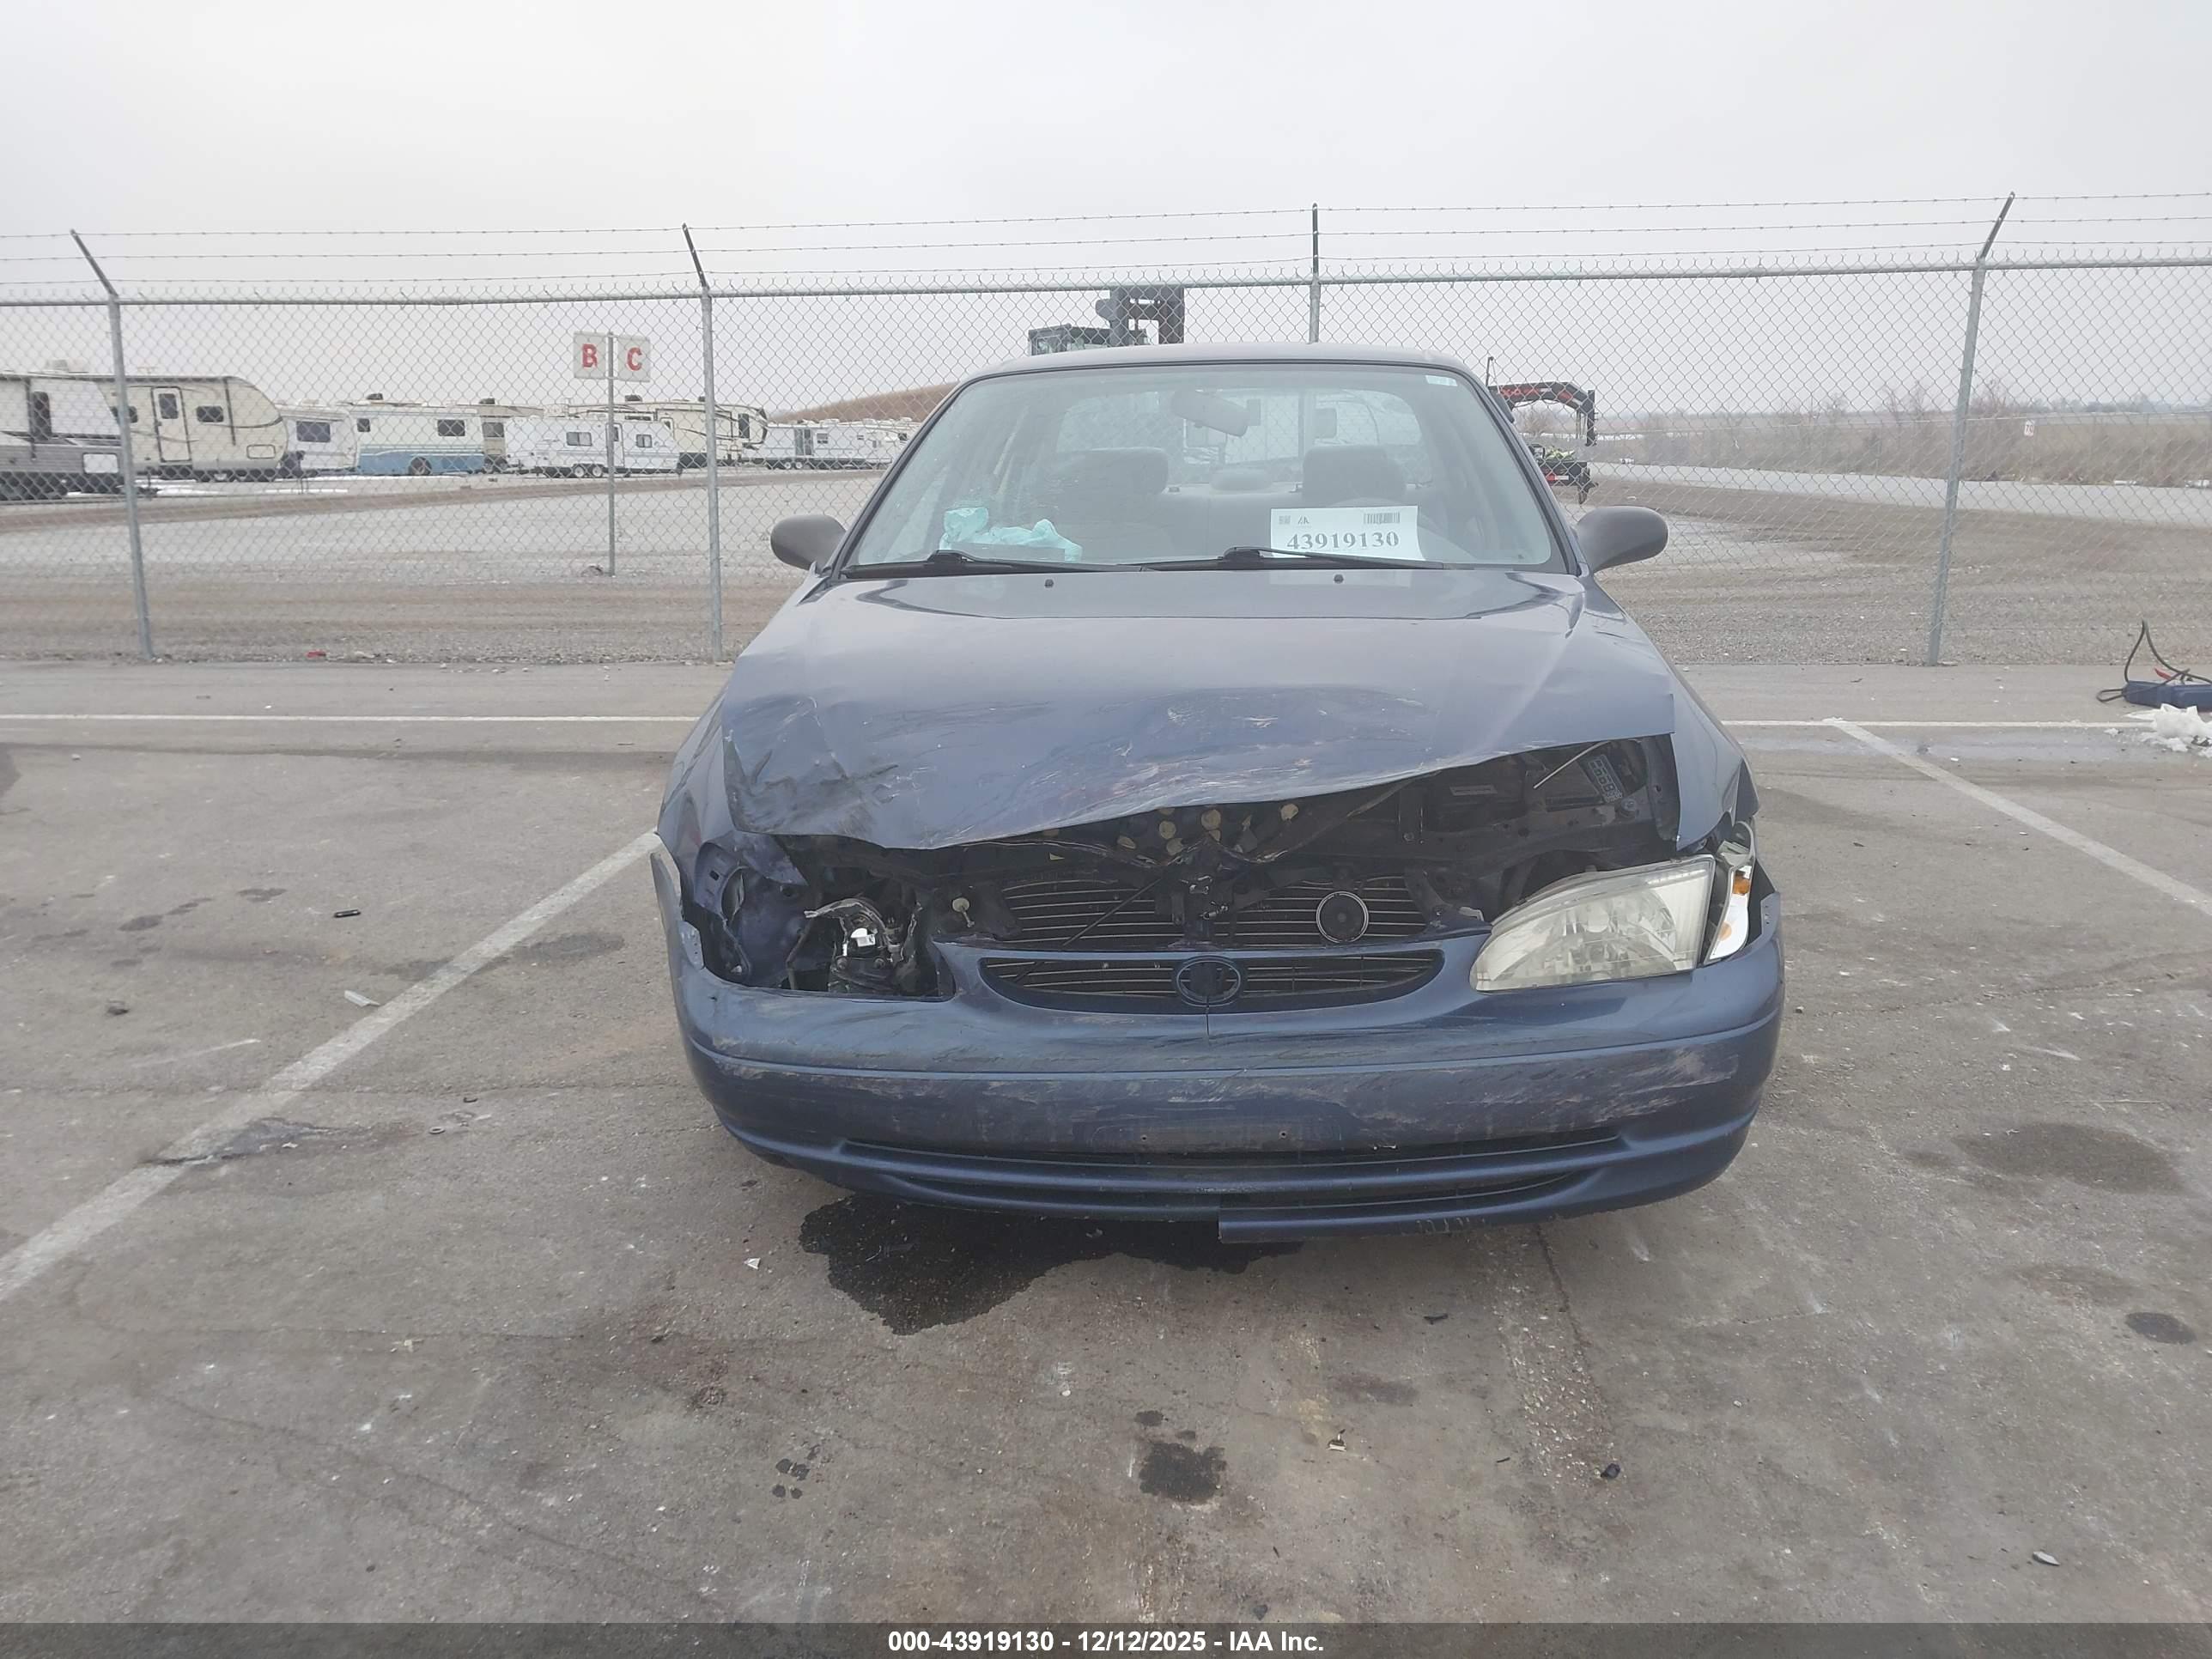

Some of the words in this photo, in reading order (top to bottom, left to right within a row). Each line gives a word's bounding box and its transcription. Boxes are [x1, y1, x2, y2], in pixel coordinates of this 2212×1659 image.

[581, 343, 598, 368] B
[627, 347, 642, 371] C
[1286, 531, 1400, 550] 43919130
